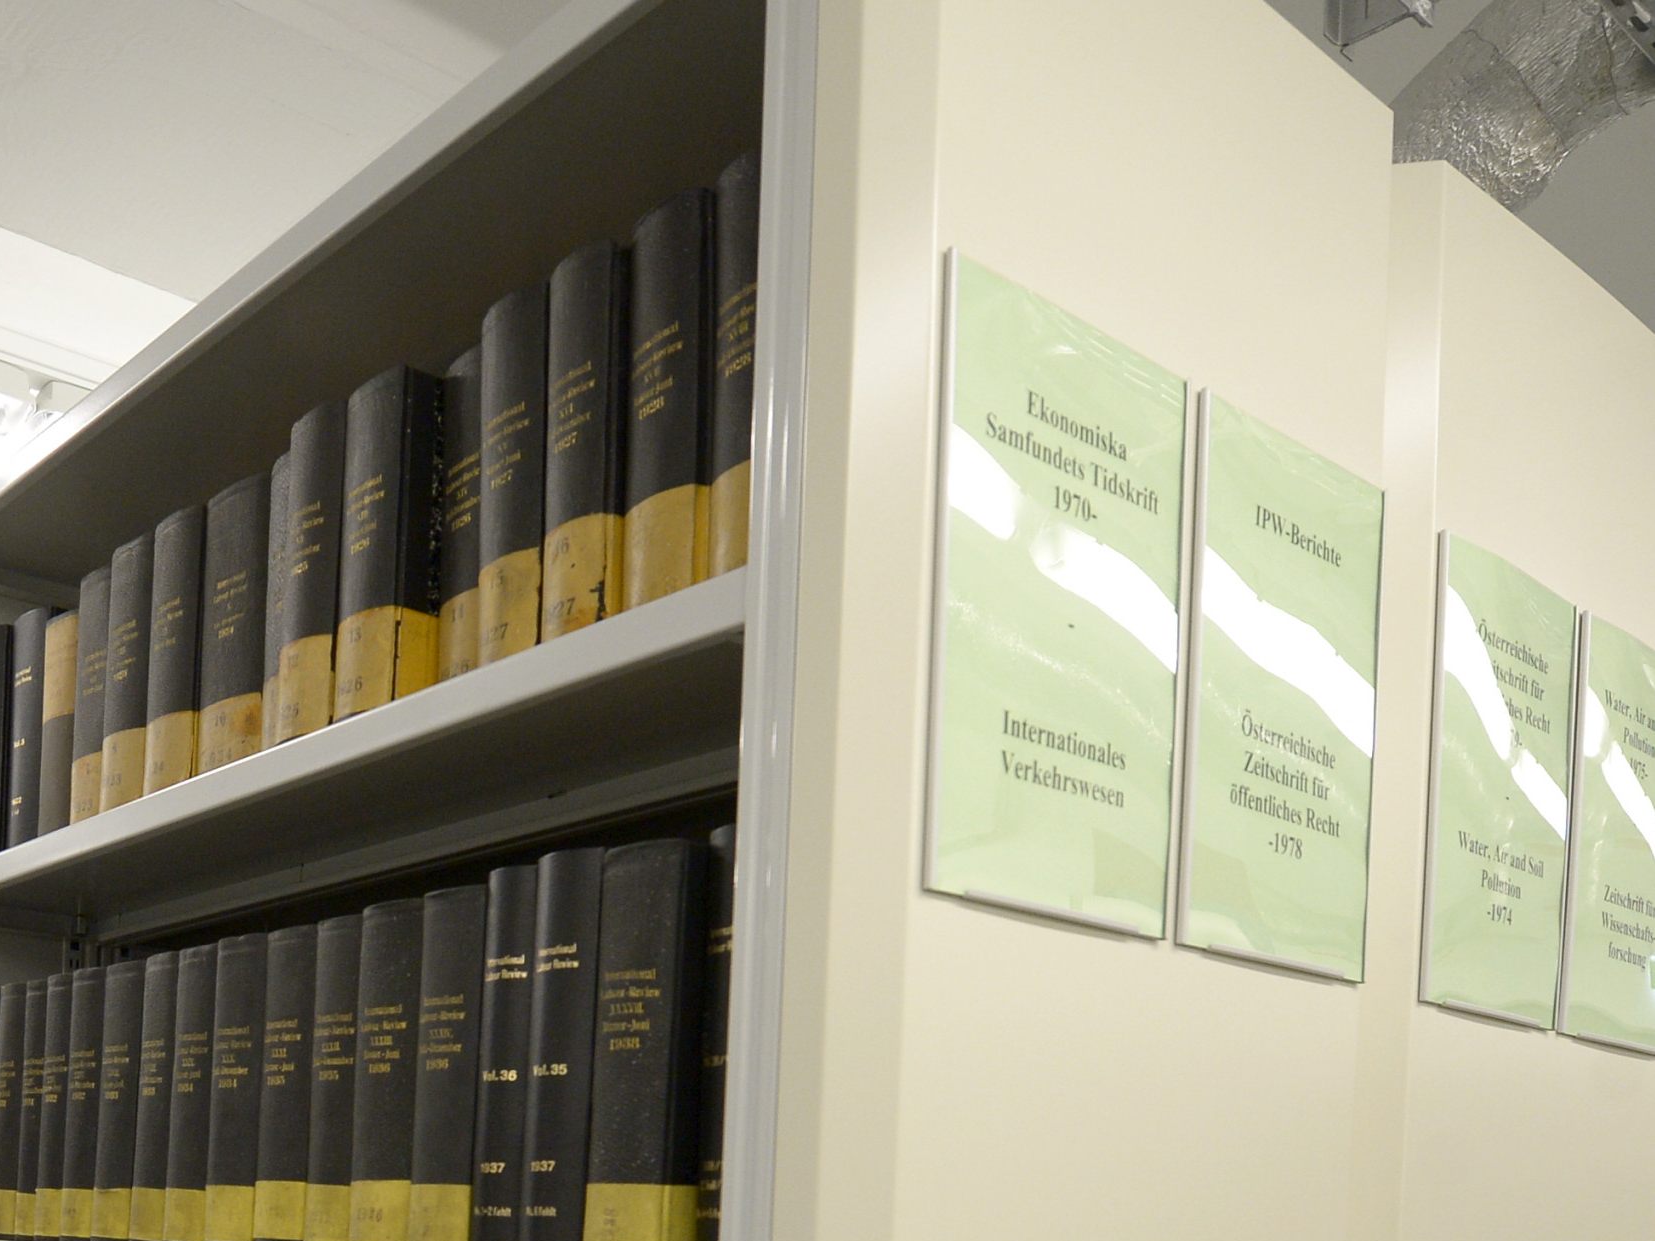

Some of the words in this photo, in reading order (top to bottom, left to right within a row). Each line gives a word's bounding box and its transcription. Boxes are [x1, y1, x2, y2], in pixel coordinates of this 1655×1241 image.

[1027, 389, 1127, 461] Ekonomiska
[986, 412, 1085, 480] Samfundets
[1090, 462, 1158, 514] Tidskrift
[1054, 485, 1098, 522] 1970-
[1256, 505, 1341, 567] IPW-Berichte
[1478, 618, 1548, 674] Österreichische
[1493, 660, 1528, 694] itschrift
[1531, 680, 1545, 701] für
[1526, 706, 1550, 734] Recht
[1605, 689, 1632, 719] Water,
[1635, 707, 1646, 725] Air
[1003, 710, 1126, 770] Internationales
[1241, 709, 1336, 769] Österreichische
[1001, 750, 1124, 807] Verkehrswesen
[1243, 751, 1309, 794] Zeitschrift
[1312, 775, 1330, 801] für
[1230, 783, 1302, 826] öffentliches
[1306, 808, 1340, 837] Recht
[1268, 832, 1303, 859] -1978
[1458, 830, 1491, 860] Water,
[1494, 845, 1508, 864] Air
[1510, 854, 1526, 871] and
[1528, 856, 1544, 878] Soil
[1481, 869, 1521, 899] Pollution
[1604, 884, 1644, 914] Zeitschrift
[1487, 903, 1512, 925] -1974
[1608, 941, 1647, 972] forschung
[481, 1162, 506, 1174] 1937
[531, 1160, 556, 1172] 1937
